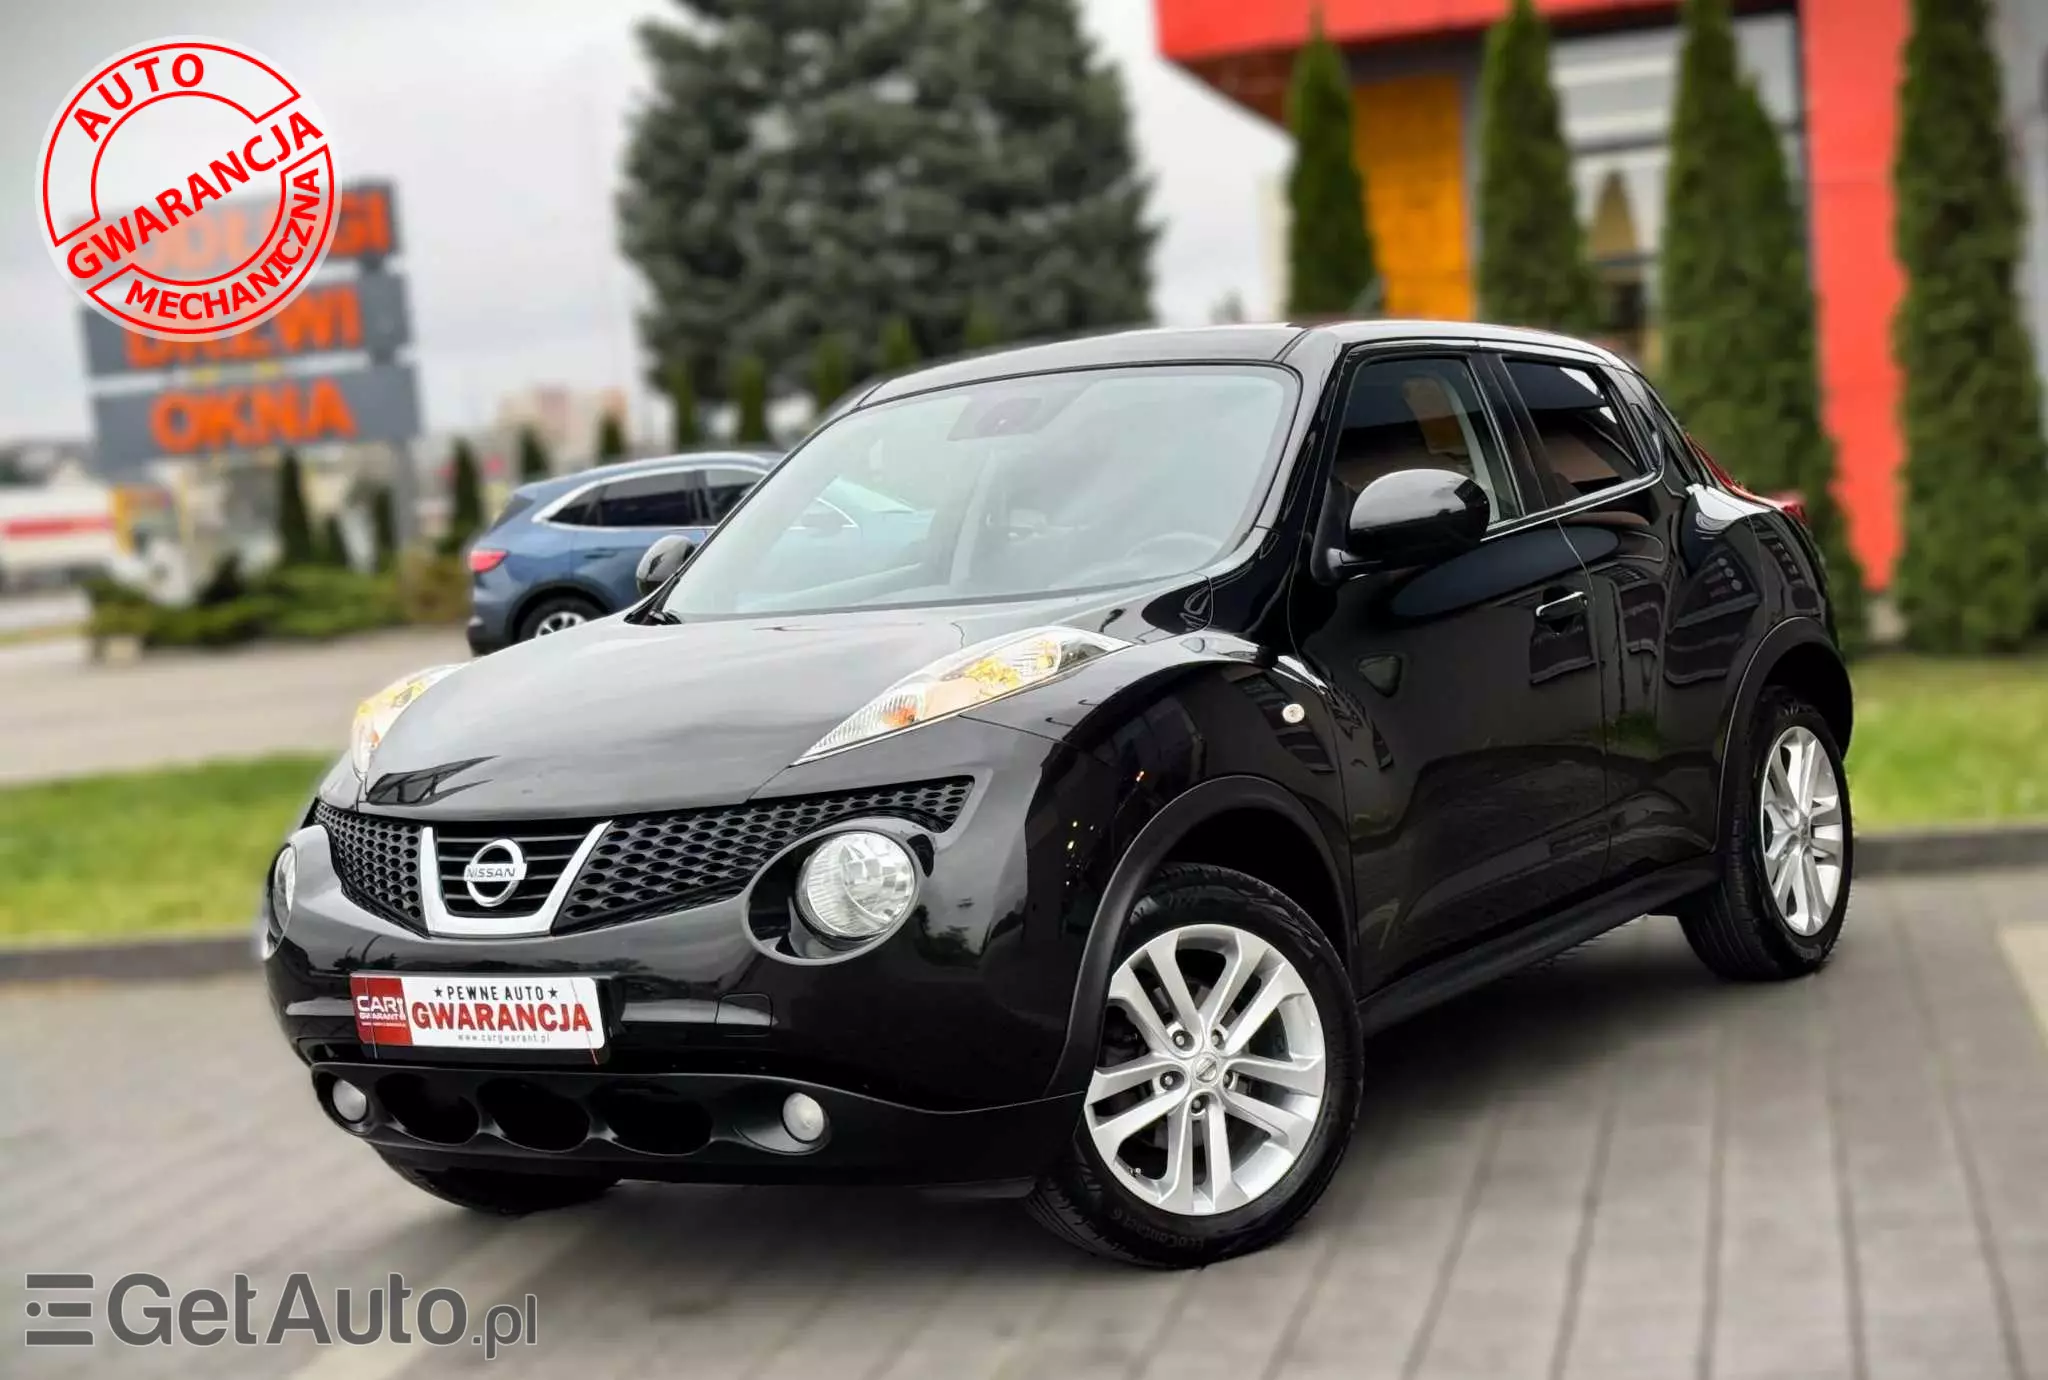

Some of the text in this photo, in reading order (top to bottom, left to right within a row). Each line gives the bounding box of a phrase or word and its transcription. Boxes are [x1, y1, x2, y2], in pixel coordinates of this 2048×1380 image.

[149, 377, 355, 452] OKNA
[466, 867, 516, 878] NISSAN
[447, 985, 545, 1001] PEWNE AUTO
[411, 1001, 593, 1032] GWARANCJA
